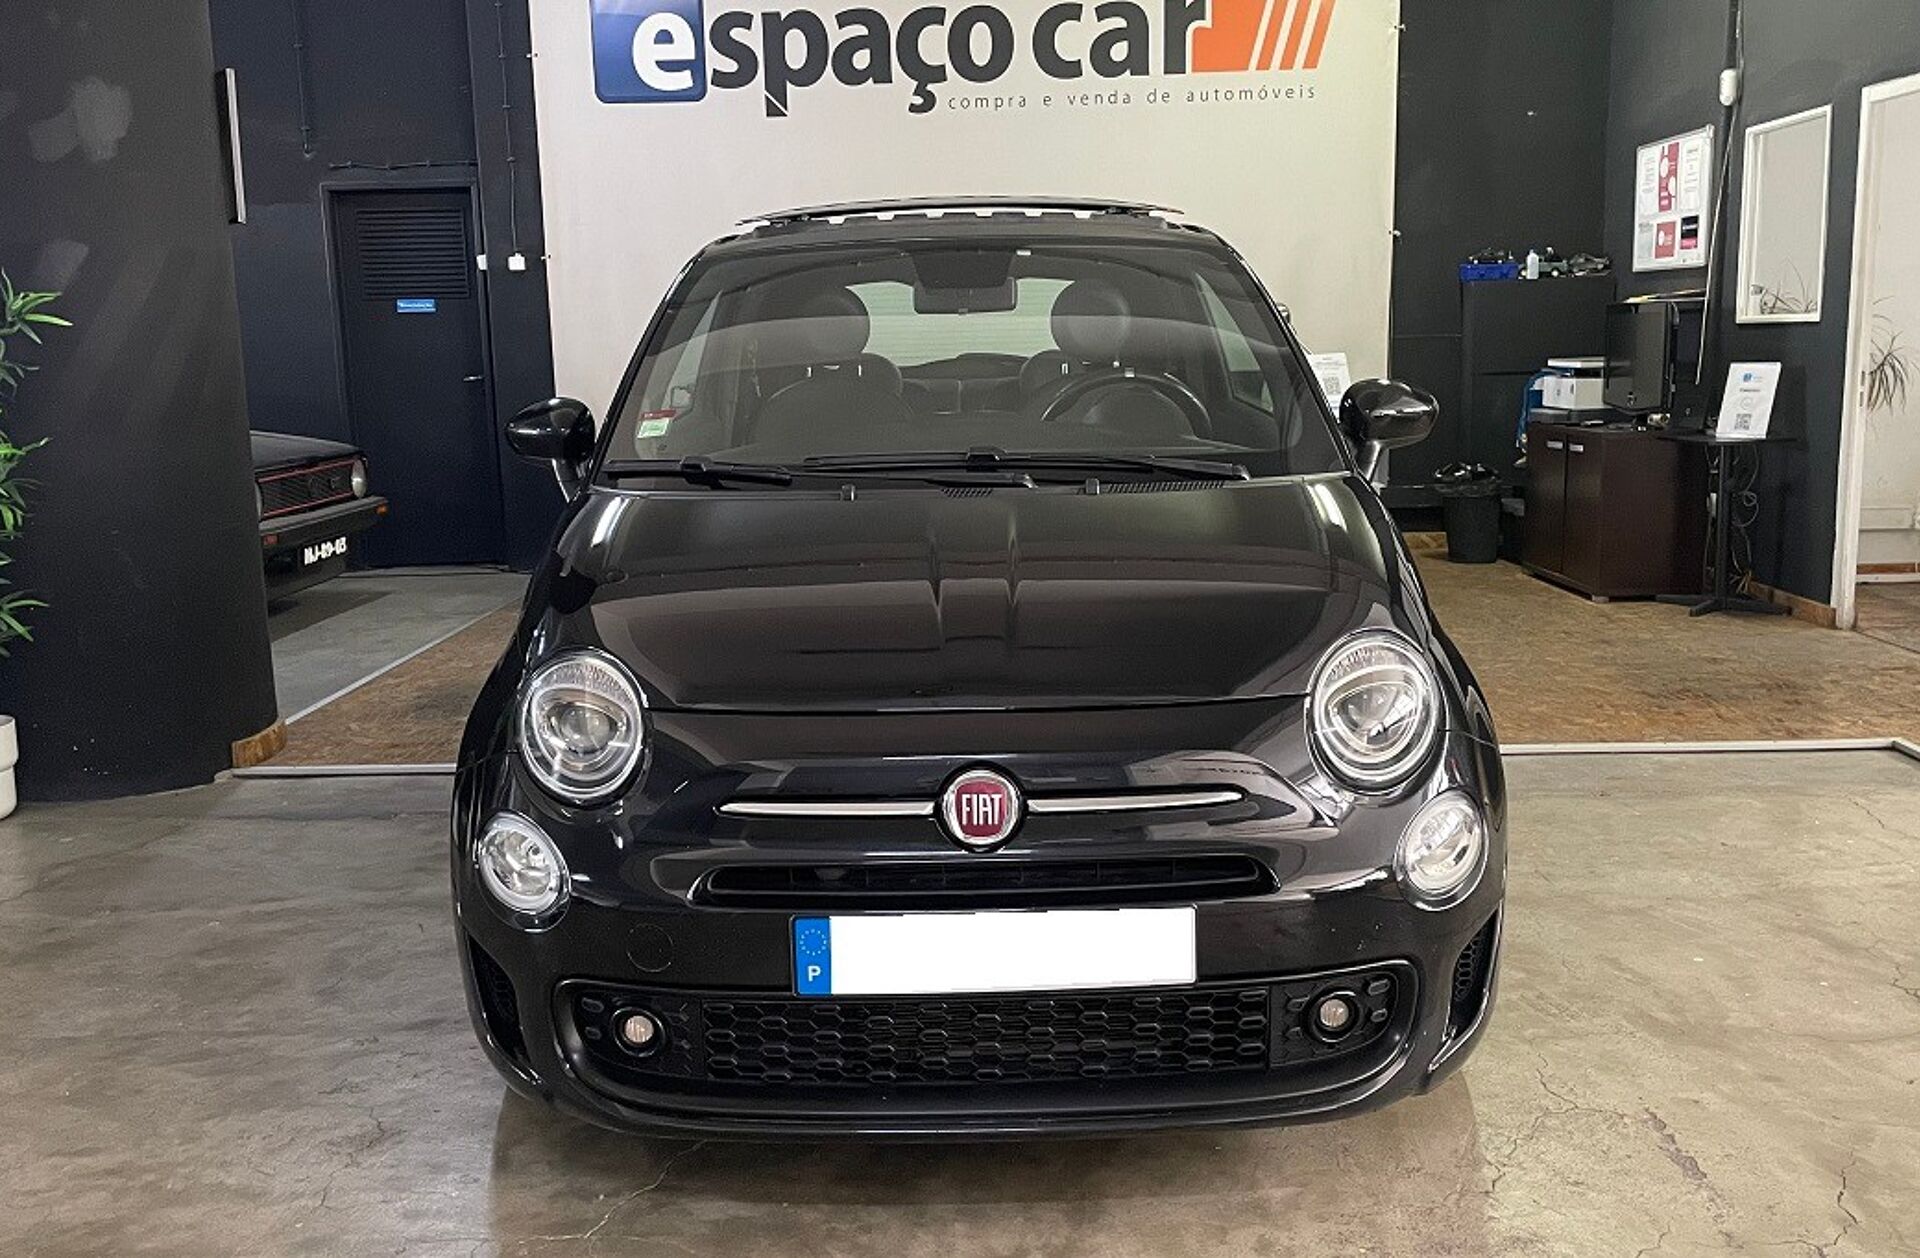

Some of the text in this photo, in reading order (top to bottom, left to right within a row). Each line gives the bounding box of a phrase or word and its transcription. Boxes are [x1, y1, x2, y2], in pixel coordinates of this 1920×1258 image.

[633, 0, 1206, 117] espaço car
[948, 84, 1315, 111] compra e venda de automóveis
[961, 793, 1003, 826] FIAT
[807, 965, 821, 982] P
